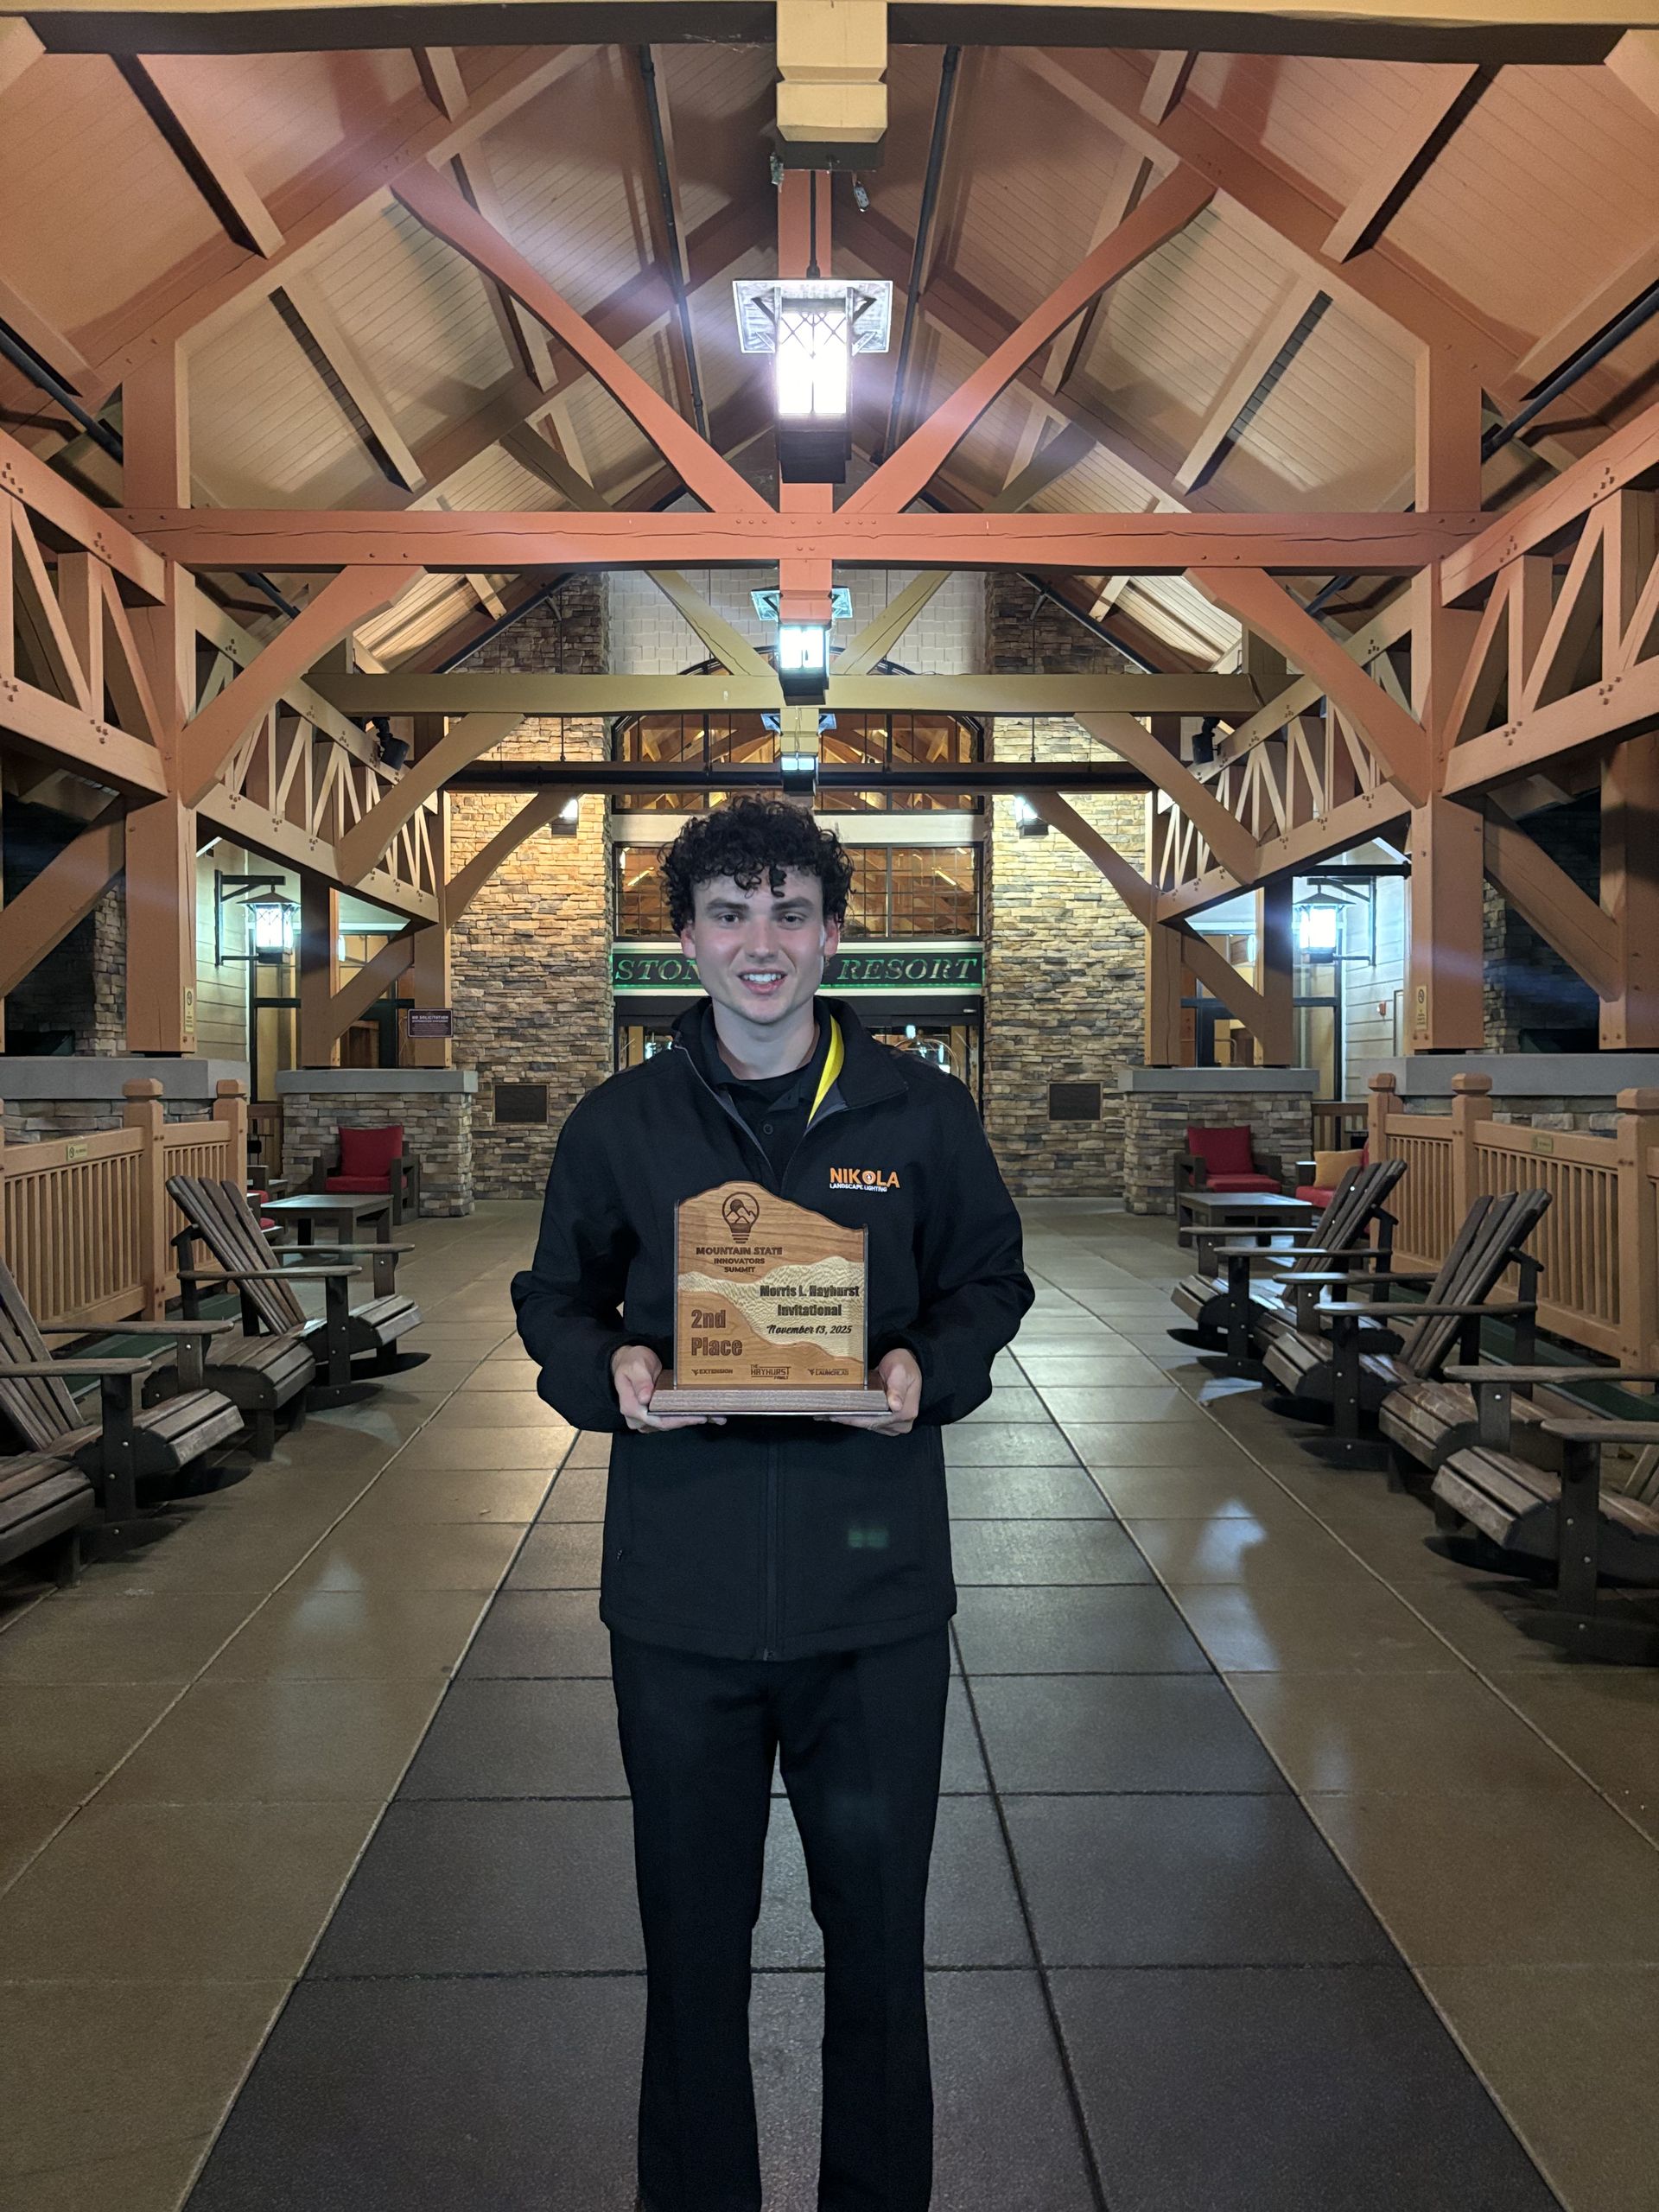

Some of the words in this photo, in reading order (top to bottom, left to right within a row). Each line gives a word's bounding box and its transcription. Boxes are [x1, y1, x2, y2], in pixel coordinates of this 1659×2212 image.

[836, 958, 977, 980] RESORT
[830, 1167, 900, 1188] NIKOLA
[760, 1285, 797, 1296] Morris
[798, 1285, 807, 1296] L.
[809, 1285, 860, 1298] Hayhurst
[691, 1309, 726, 1328] 2nd
[778, 1305, 842, 1316] Invitational
[766, 1324, 814, 1334] November
[816, 1325, 828, 1335] 13,
[830, 1325, 853, 1334] 2025
[691, 1337, 743, 1356] Place
